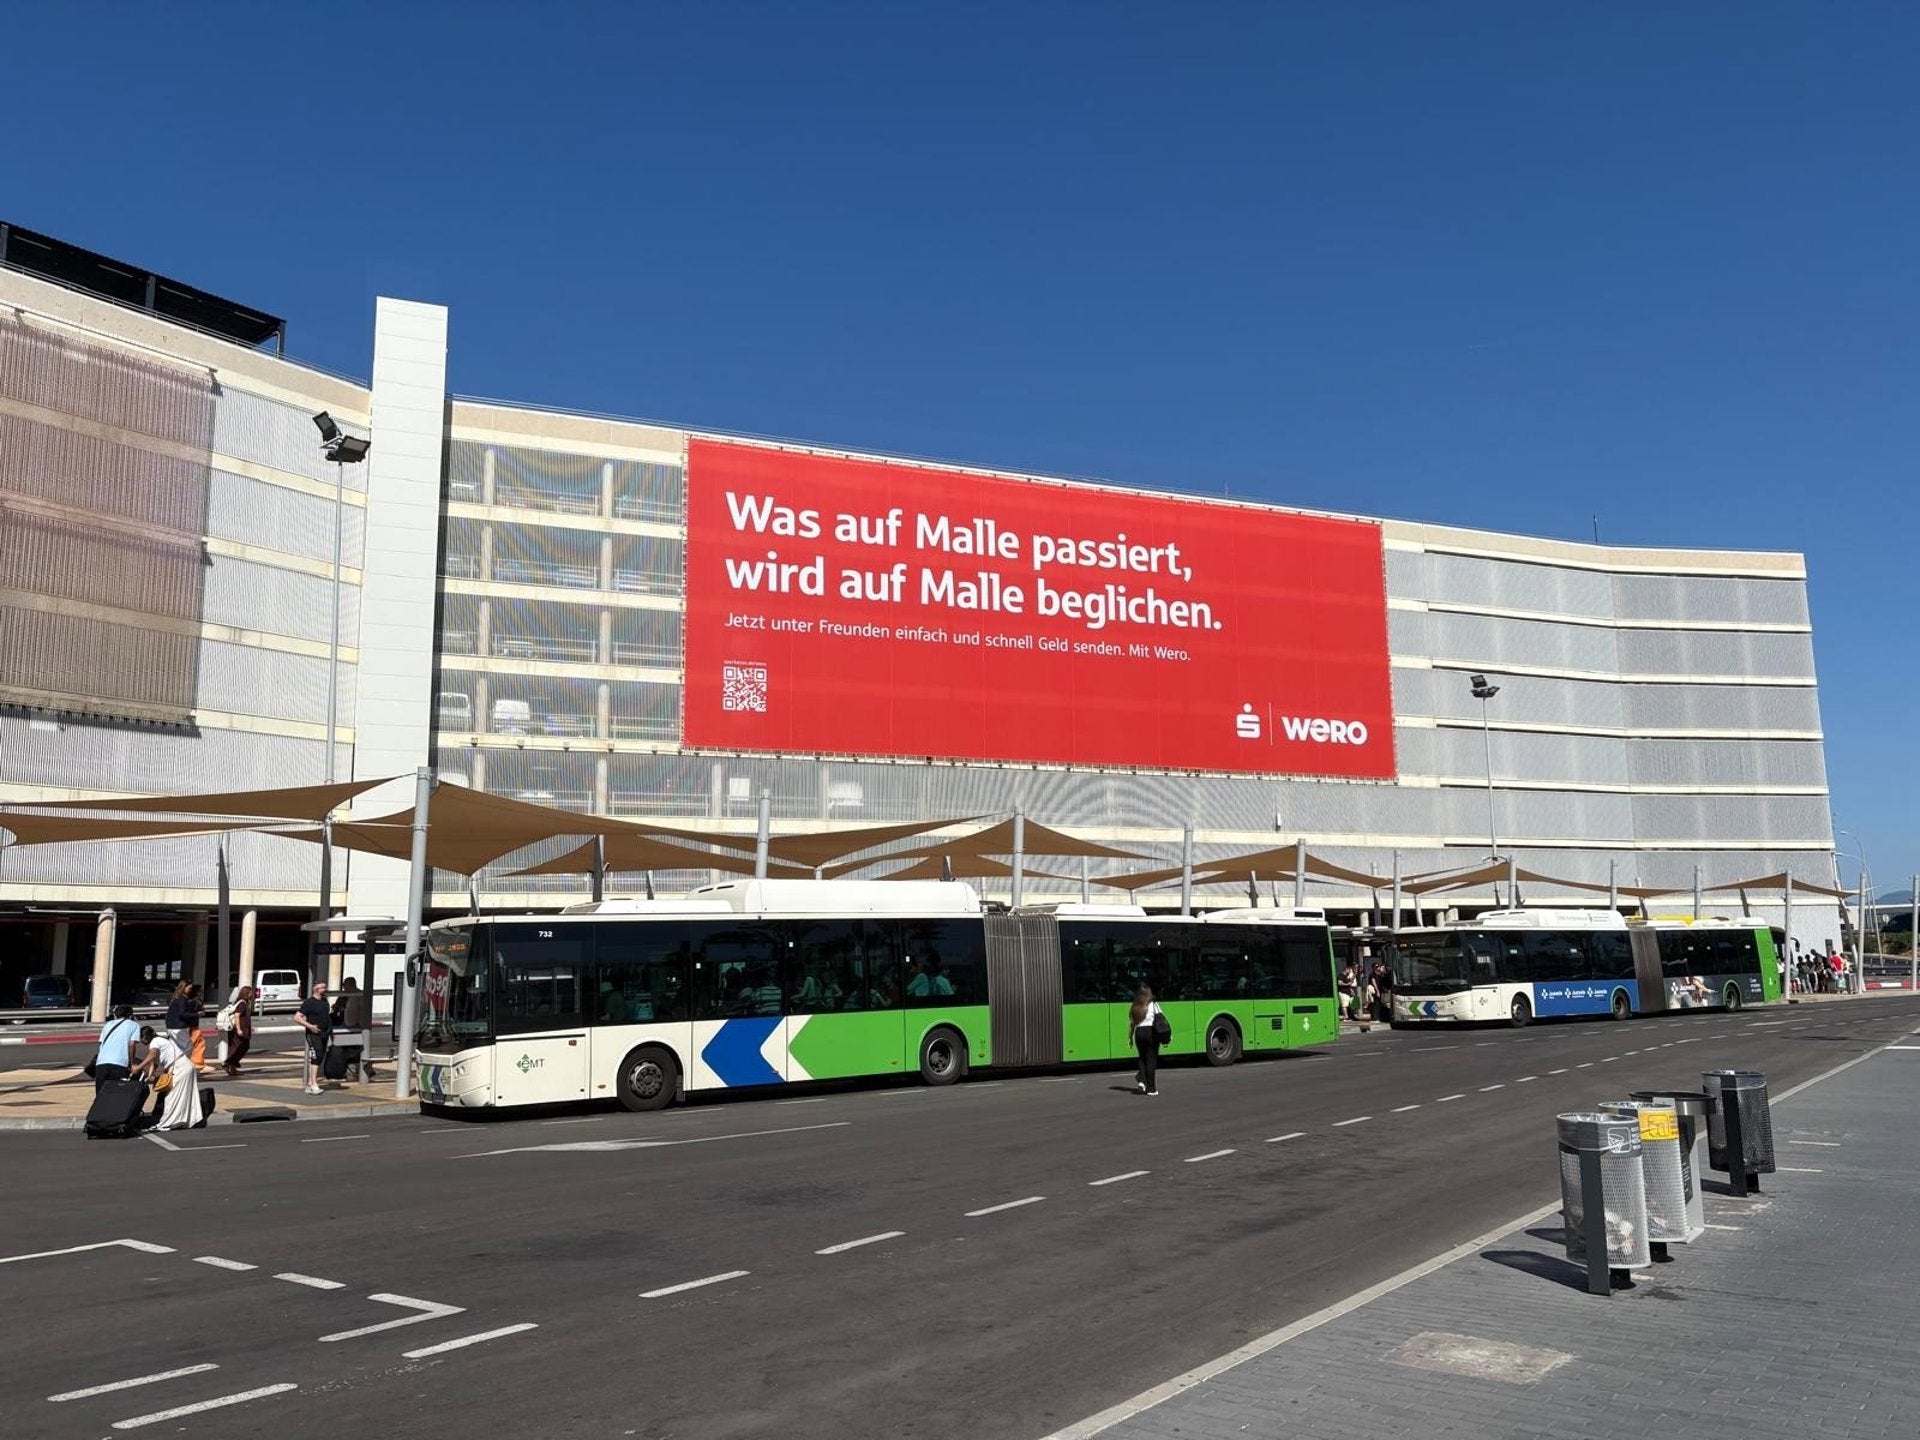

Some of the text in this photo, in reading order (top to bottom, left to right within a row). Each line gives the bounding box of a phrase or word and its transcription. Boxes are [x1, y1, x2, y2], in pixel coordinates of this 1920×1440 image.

[725, 491, 1193, 582] Was auf Malle passiert,
[725, 550, 1223, 630] wird auf Malle beglichen.
[724, 612, 1191, 661] Jetzt unter Freunden einfach und schnell Geld senden. Mit Wero.
[538, 930, 553, 938] 732
